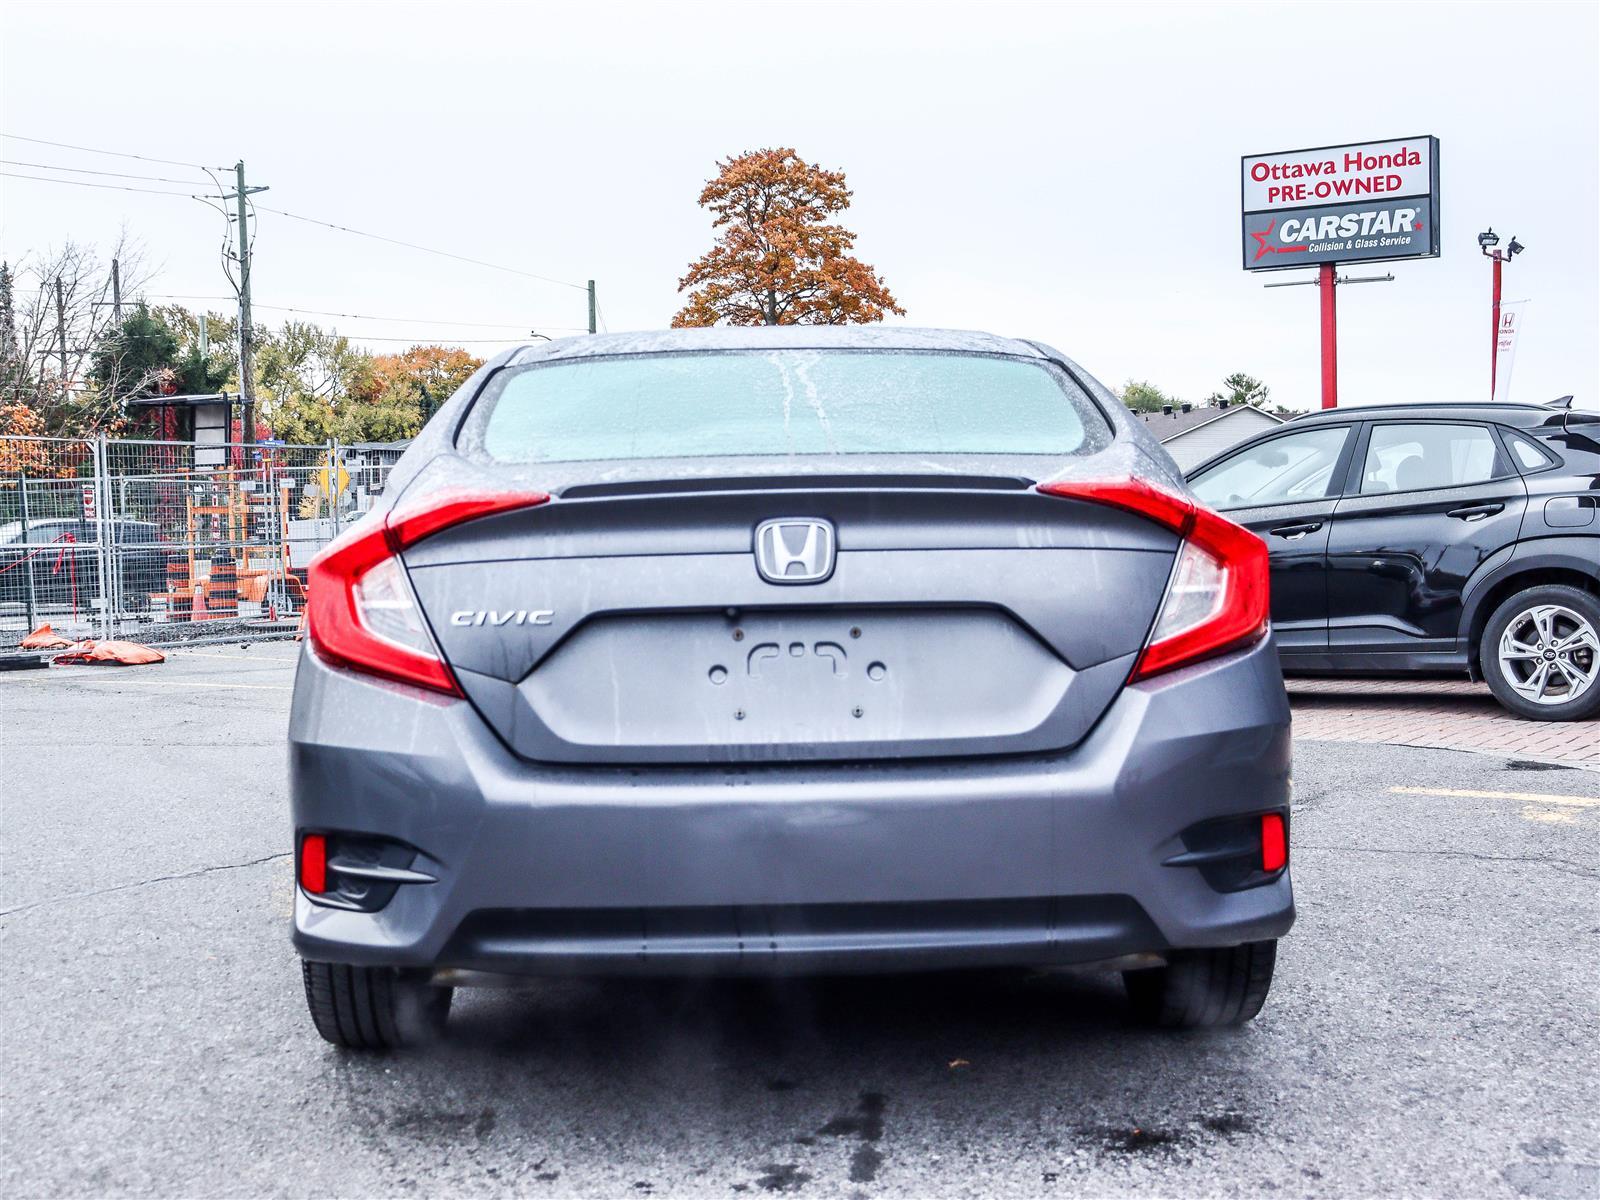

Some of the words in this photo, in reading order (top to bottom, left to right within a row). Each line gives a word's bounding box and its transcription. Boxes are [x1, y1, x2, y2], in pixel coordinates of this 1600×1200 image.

[1250, 159, 1337, 182] Ottawa
[1344, 147, 1422, 173] Honda
[1268, 174, 1403, 203] PRE-OWNED
[1308, 240, 1345, 253] Collision
[1346, 240, 1353, 250] &
[1355, 238, 1378, 249] Glass
[1379, 235, 1411, 247] Service
[450, 609, 556, 627] CIVIC
